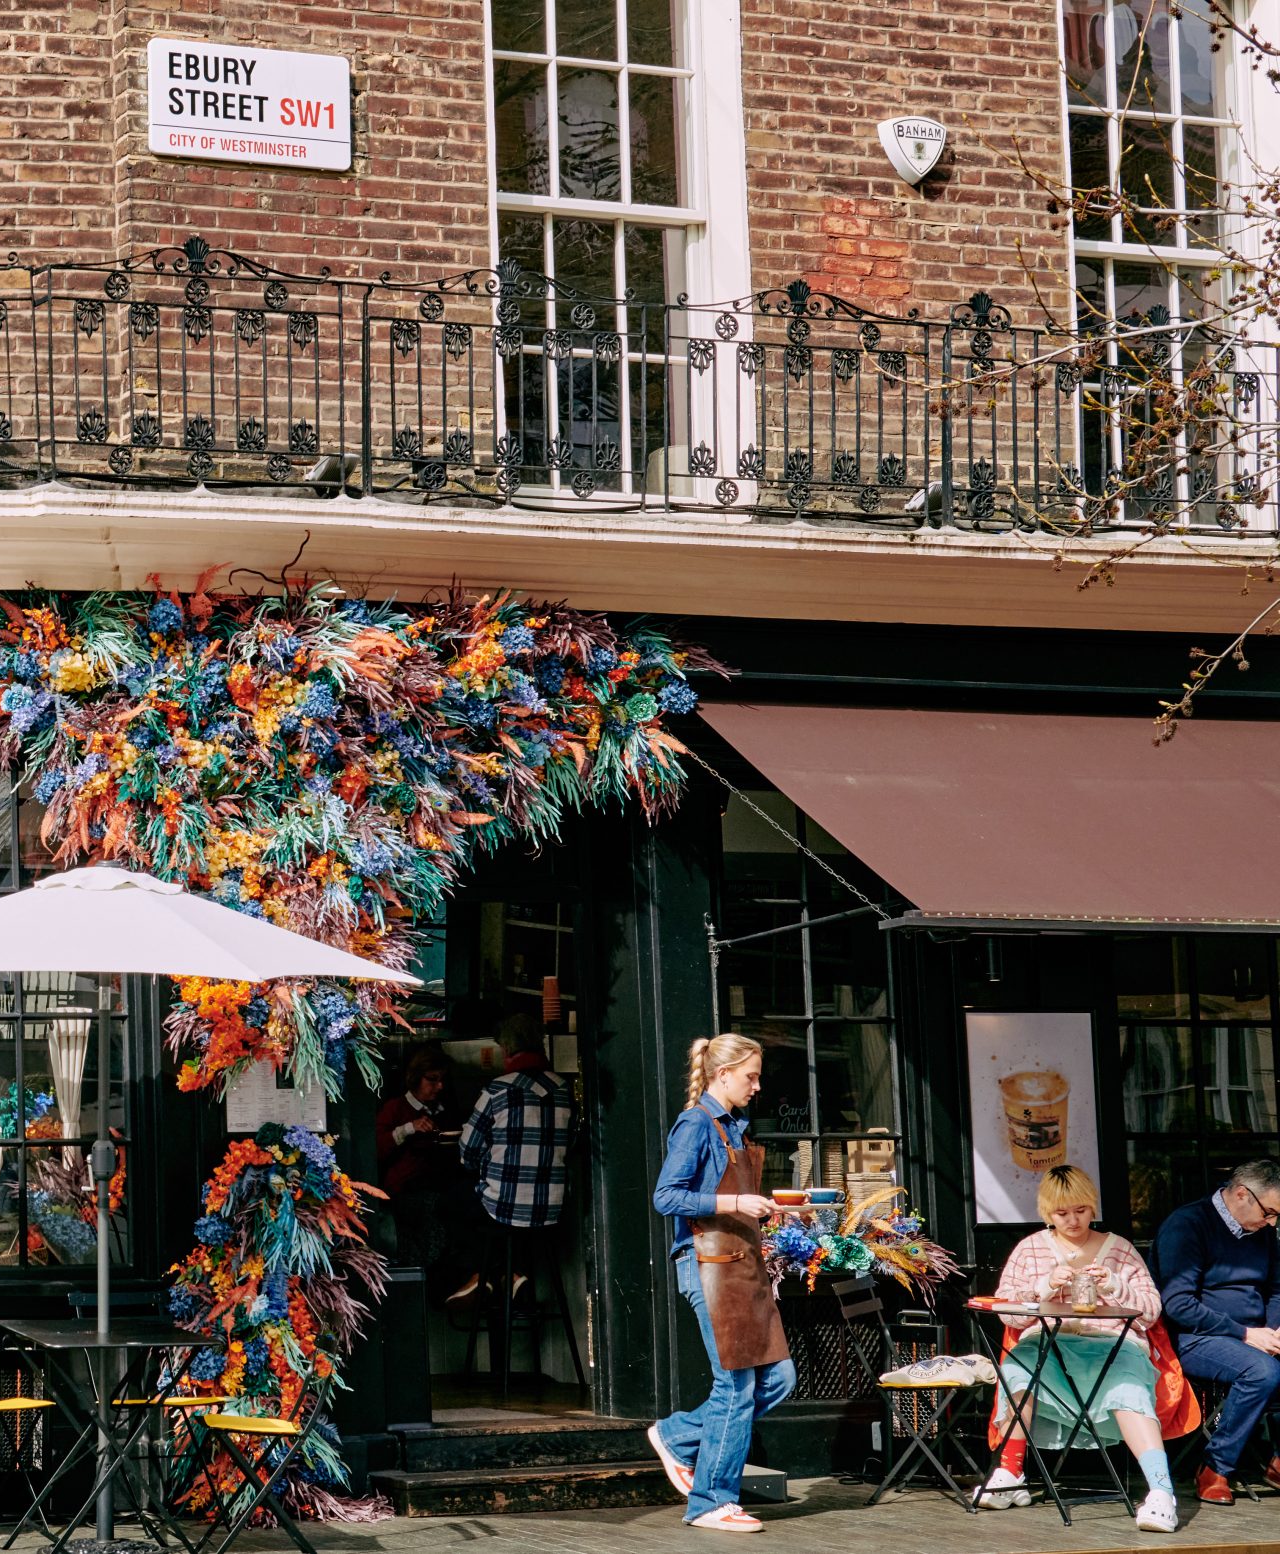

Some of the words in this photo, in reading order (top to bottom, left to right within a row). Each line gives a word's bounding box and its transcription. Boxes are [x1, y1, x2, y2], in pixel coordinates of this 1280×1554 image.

[169, 52, 257, 86] EBURY
[169, 87, 269, 123] STREET
[280, 97, 335, 130] SW1
[897, 124, 942, 139] BANHAM
[169, 133, 197, 148] CITY
[201, 136, 216, 149] OF
[221, 138, 307, 159] WESTMINSTER
[779, 1100, 810, 1117] Card
[780, 1116, 810, 1134] Only
